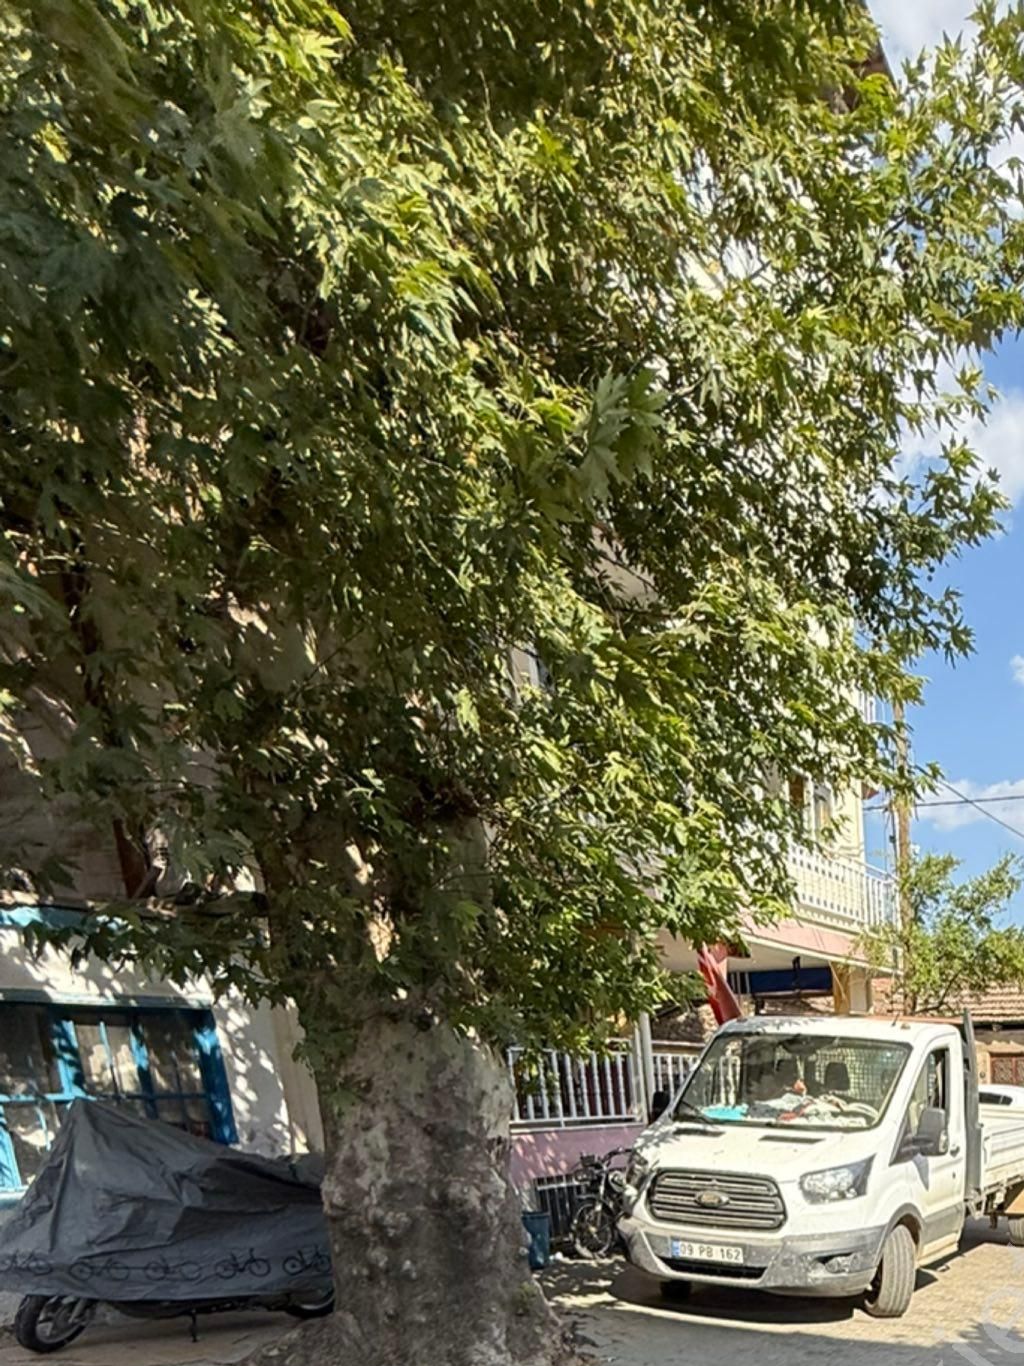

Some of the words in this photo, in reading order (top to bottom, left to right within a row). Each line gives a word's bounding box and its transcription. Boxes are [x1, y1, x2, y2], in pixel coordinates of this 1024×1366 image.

[680, 1243, 694, 1256] 09
[698, 1245, 714, 1258] PB
[720, 1247, 741, 1260] 162
